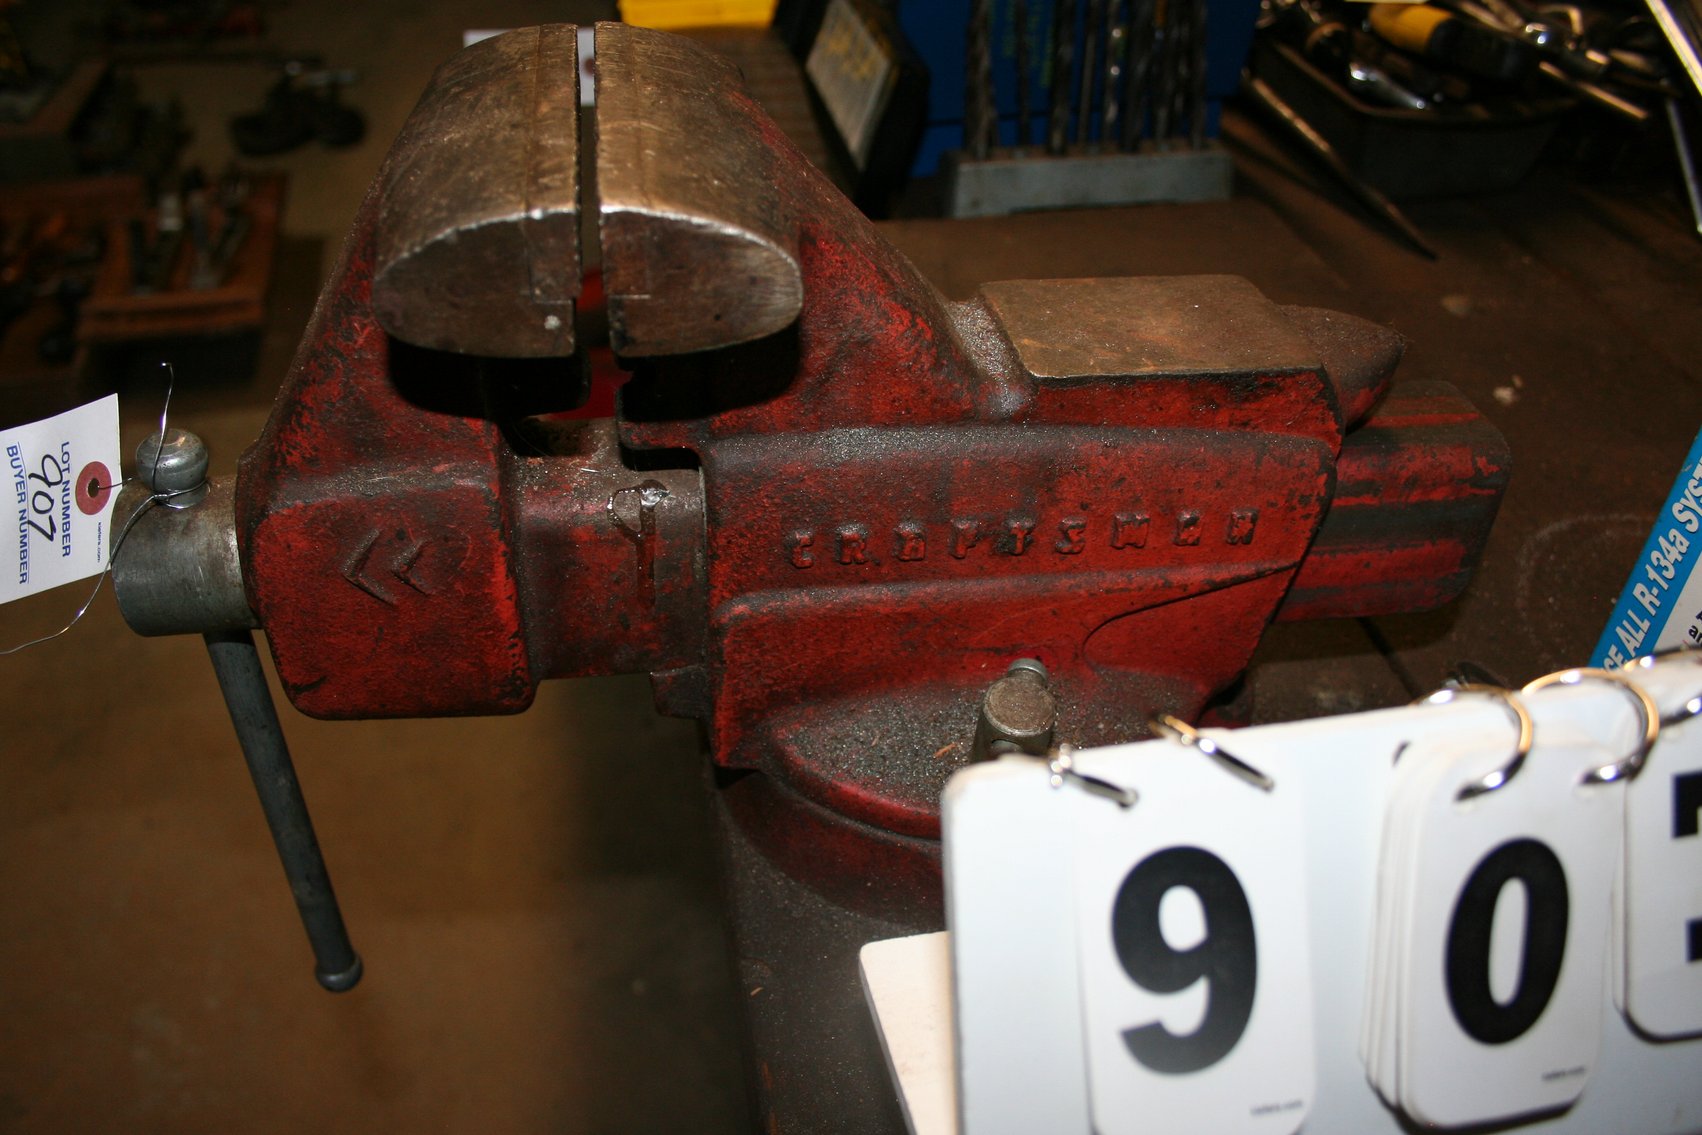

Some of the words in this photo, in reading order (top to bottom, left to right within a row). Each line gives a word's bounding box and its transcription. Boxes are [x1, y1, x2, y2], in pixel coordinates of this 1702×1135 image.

[27, 454, 63, 542] 907
[61, 441, 71, 475] LOT
[6, 445, 27, 504] BUYER
[18, 508, 28, 585] NUMBER
[61, 479, 71, 558] NUMBER
[1632, 528, 1690, 617] R-134a
[1615, 609, 1651, 657] ALL
[1110, 845, 1257, 1074] 9
[1444, 837, 1569, 1045] 0
